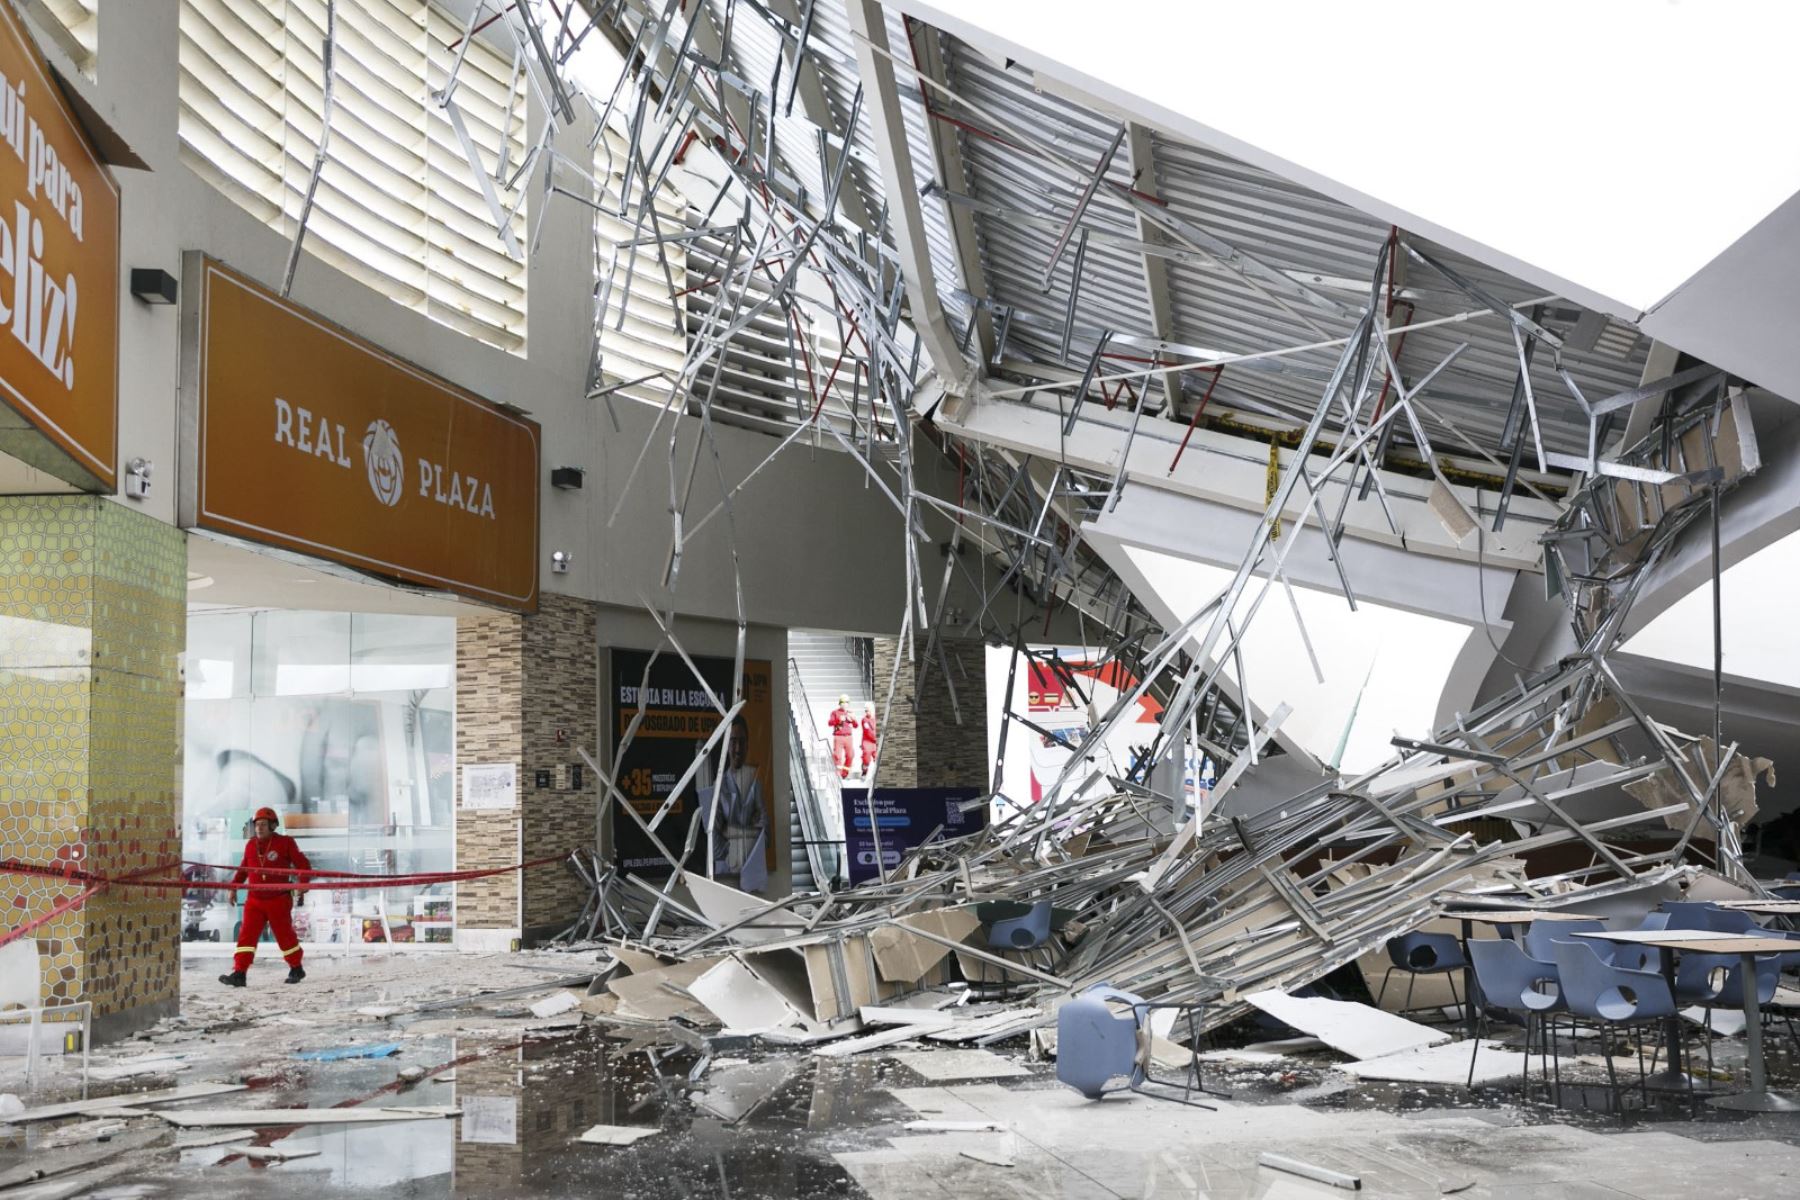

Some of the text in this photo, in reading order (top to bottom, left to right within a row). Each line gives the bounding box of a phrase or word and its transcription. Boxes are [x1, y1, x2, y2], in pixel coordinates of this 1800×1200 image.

[27, 115, 84, 243] para
[275, 398, 496, 520] REAL PLAZA
[621, 686, 660, 704] ESTIA
[662, 688, 674, 705] EN
[675, 689, 688, 706] LA
[621, 768, 652, 796] +35
